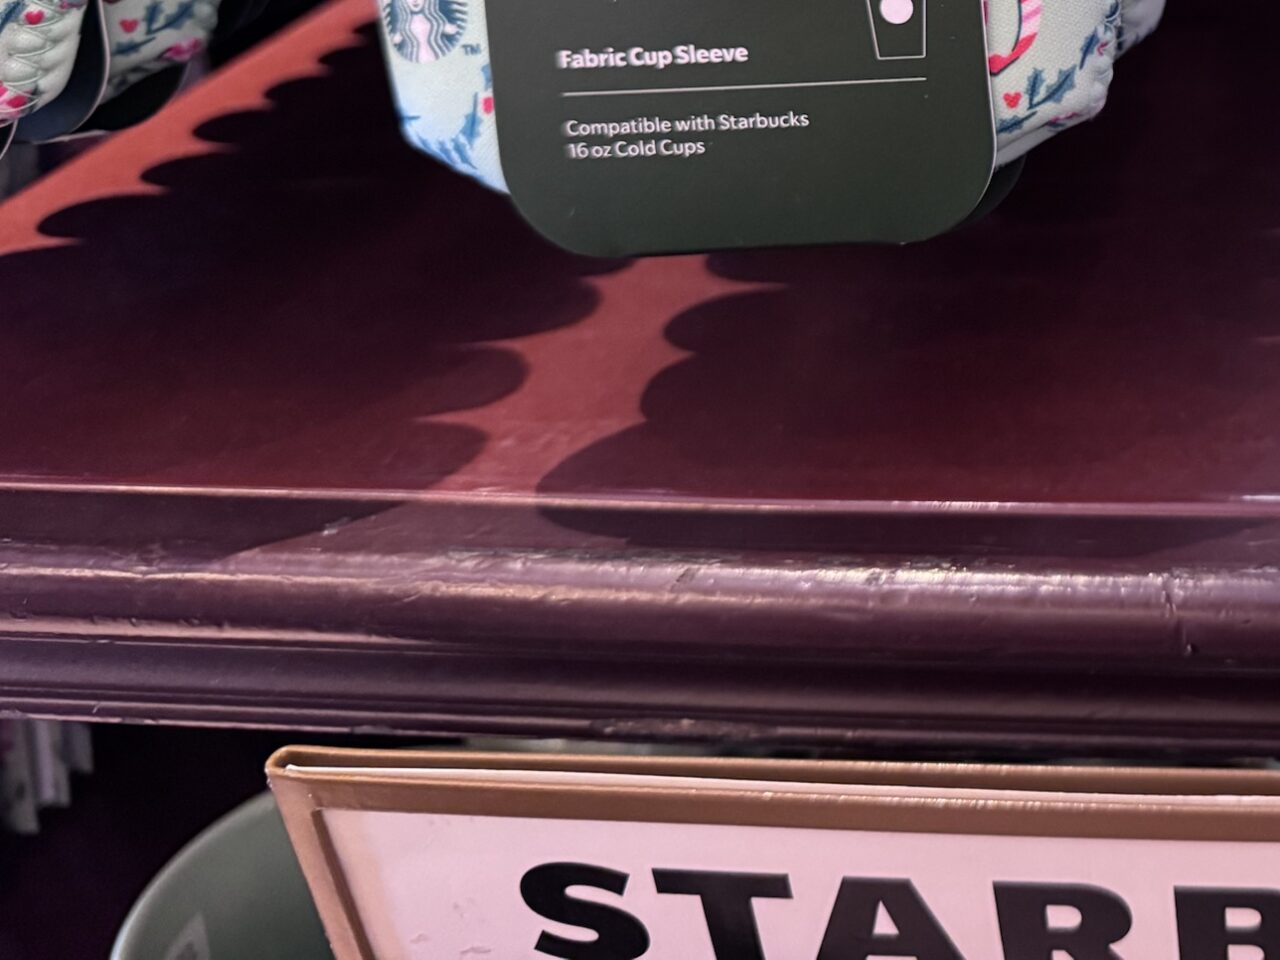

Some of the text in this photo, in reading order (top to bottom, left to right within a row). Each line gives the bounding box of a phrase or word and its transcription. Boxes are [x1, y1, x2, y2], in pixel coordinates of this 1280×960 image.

[557, 44, 749, 69] Fabric Cup Sleeve
[565, 111, 809, 138] Compatible with Starbucks
[567, 140, 706, 159] 16 oz Cold Cups
